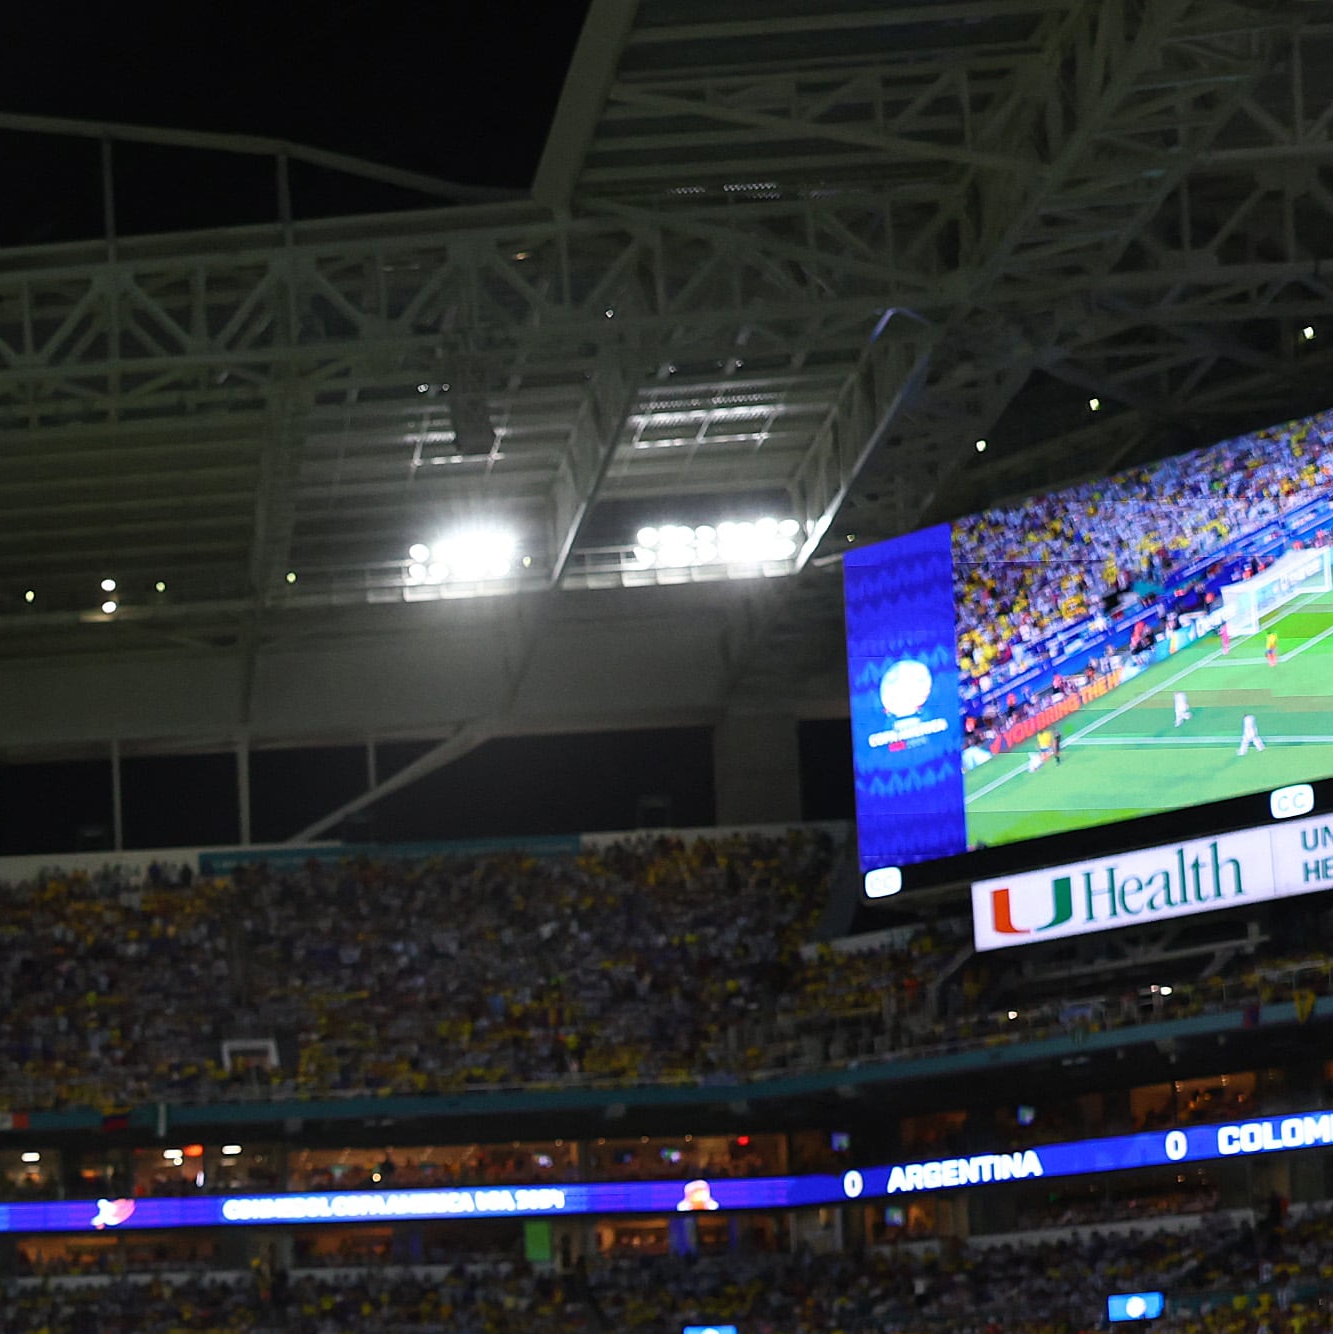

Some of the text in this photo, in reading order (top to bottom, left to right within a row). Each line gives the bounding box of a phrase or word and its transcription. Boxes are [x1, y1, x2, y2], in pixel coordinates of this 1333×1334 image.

[1164, 1130, 1187, 1161] 0
[843, 1150, 1044, 1198] 0 ARGENTINA
